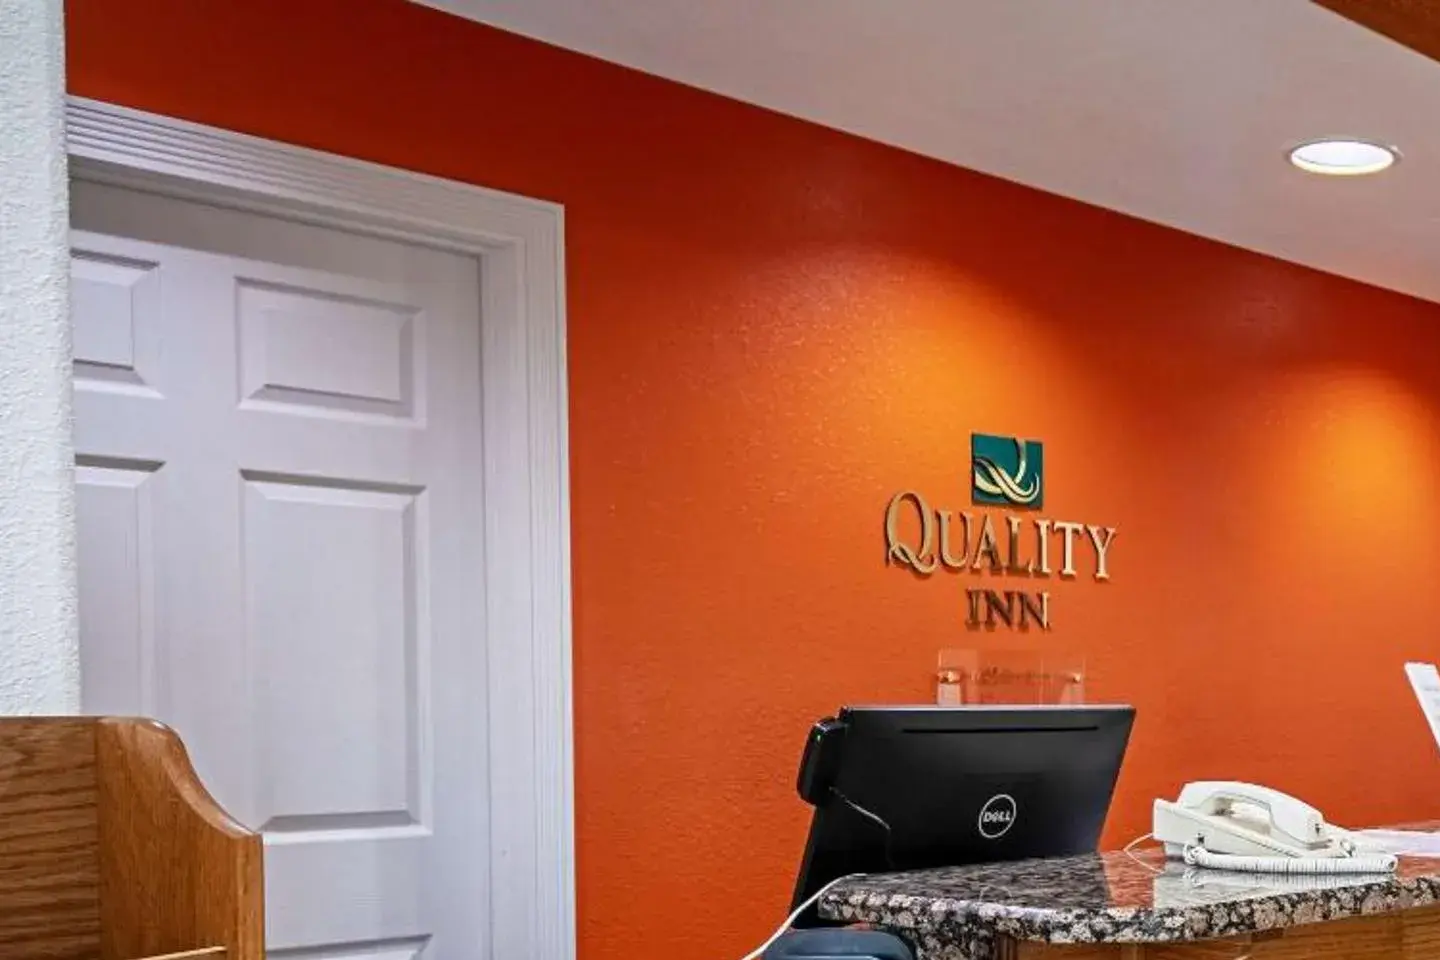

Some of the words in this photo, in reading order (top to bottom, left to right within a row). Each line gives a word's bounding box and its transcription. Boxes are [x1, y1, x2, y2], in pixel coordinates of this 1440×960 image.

[885, 491, 1117, 579] QUALITY
[966, 588, 1051, 633] INN
[983, 810, 1011, 822] DELL
